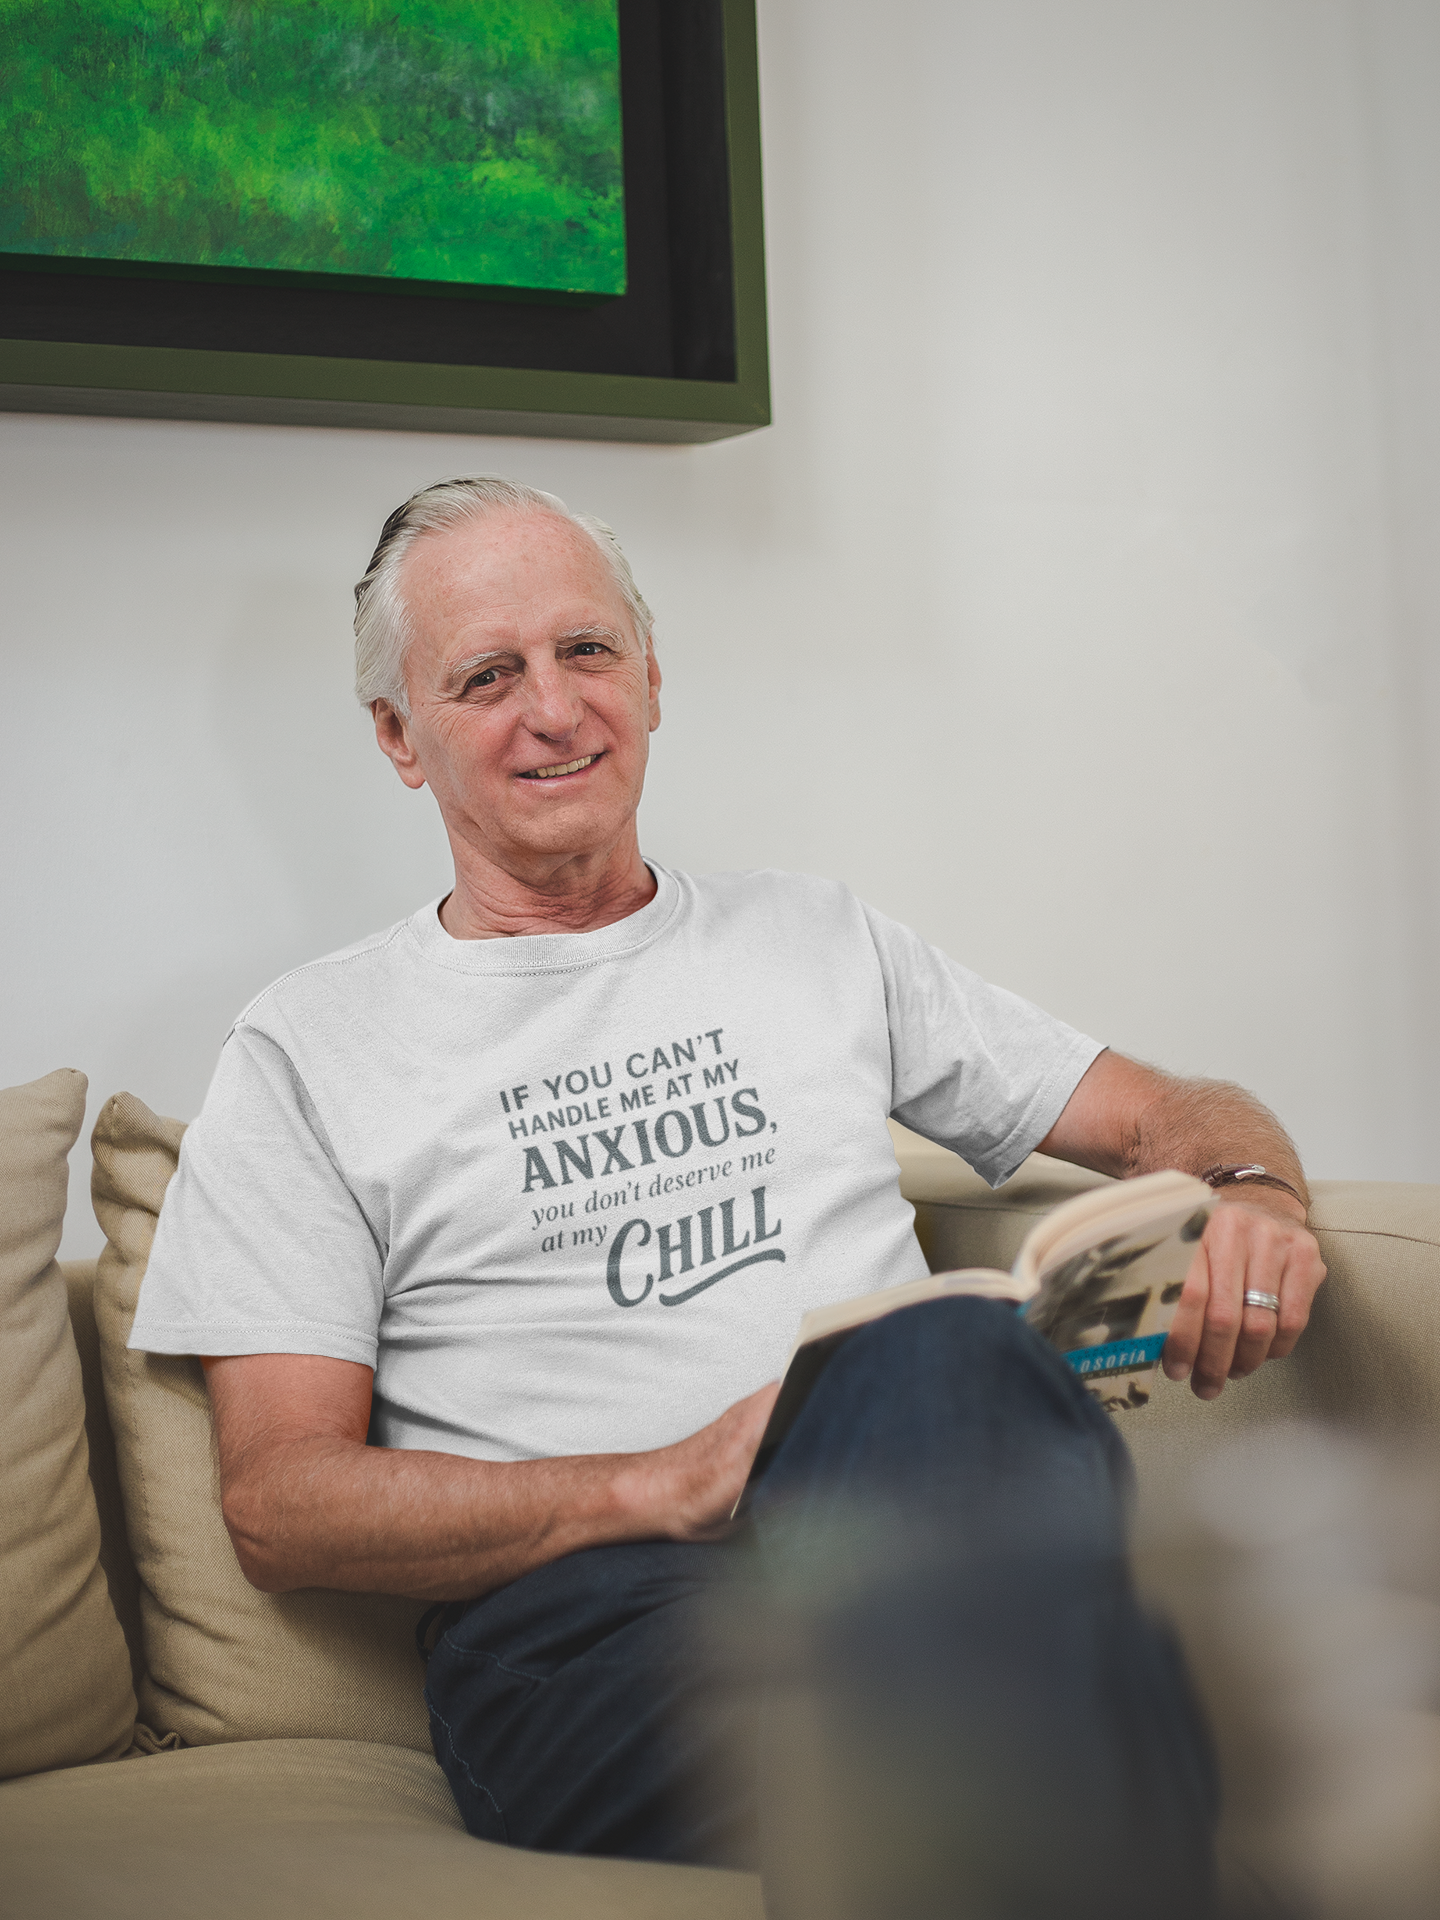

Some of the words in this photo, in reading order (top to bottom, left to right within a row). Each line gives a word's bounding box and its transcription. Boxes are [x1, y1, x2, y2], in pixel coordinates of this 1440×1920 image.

[499, 1085, 530, 1114] IF
[542, 1061, 613, 1101] YOU
[626, 1028, 725, 1080] CAN'T
[508, 1097, 612, 1140] HANDLE
[619, 1084, 656, 1113] ME
[666, 1073, 693, 1101] AT
[703, 1058, 740, 1089] MY
[521, 1087, 778, 1194] ANXIOUS,
[531, 1200, 575, 1230] you
[584, 1181, 643, 1214] don't
[648, 1159, 734, 1198] deserve
[741, 1147, 777, 1173] me
[541, 1229, 565, 1254] at
[572, 1224, 608, 1248] my
[606, 1185, 783, 1309] CHILL
